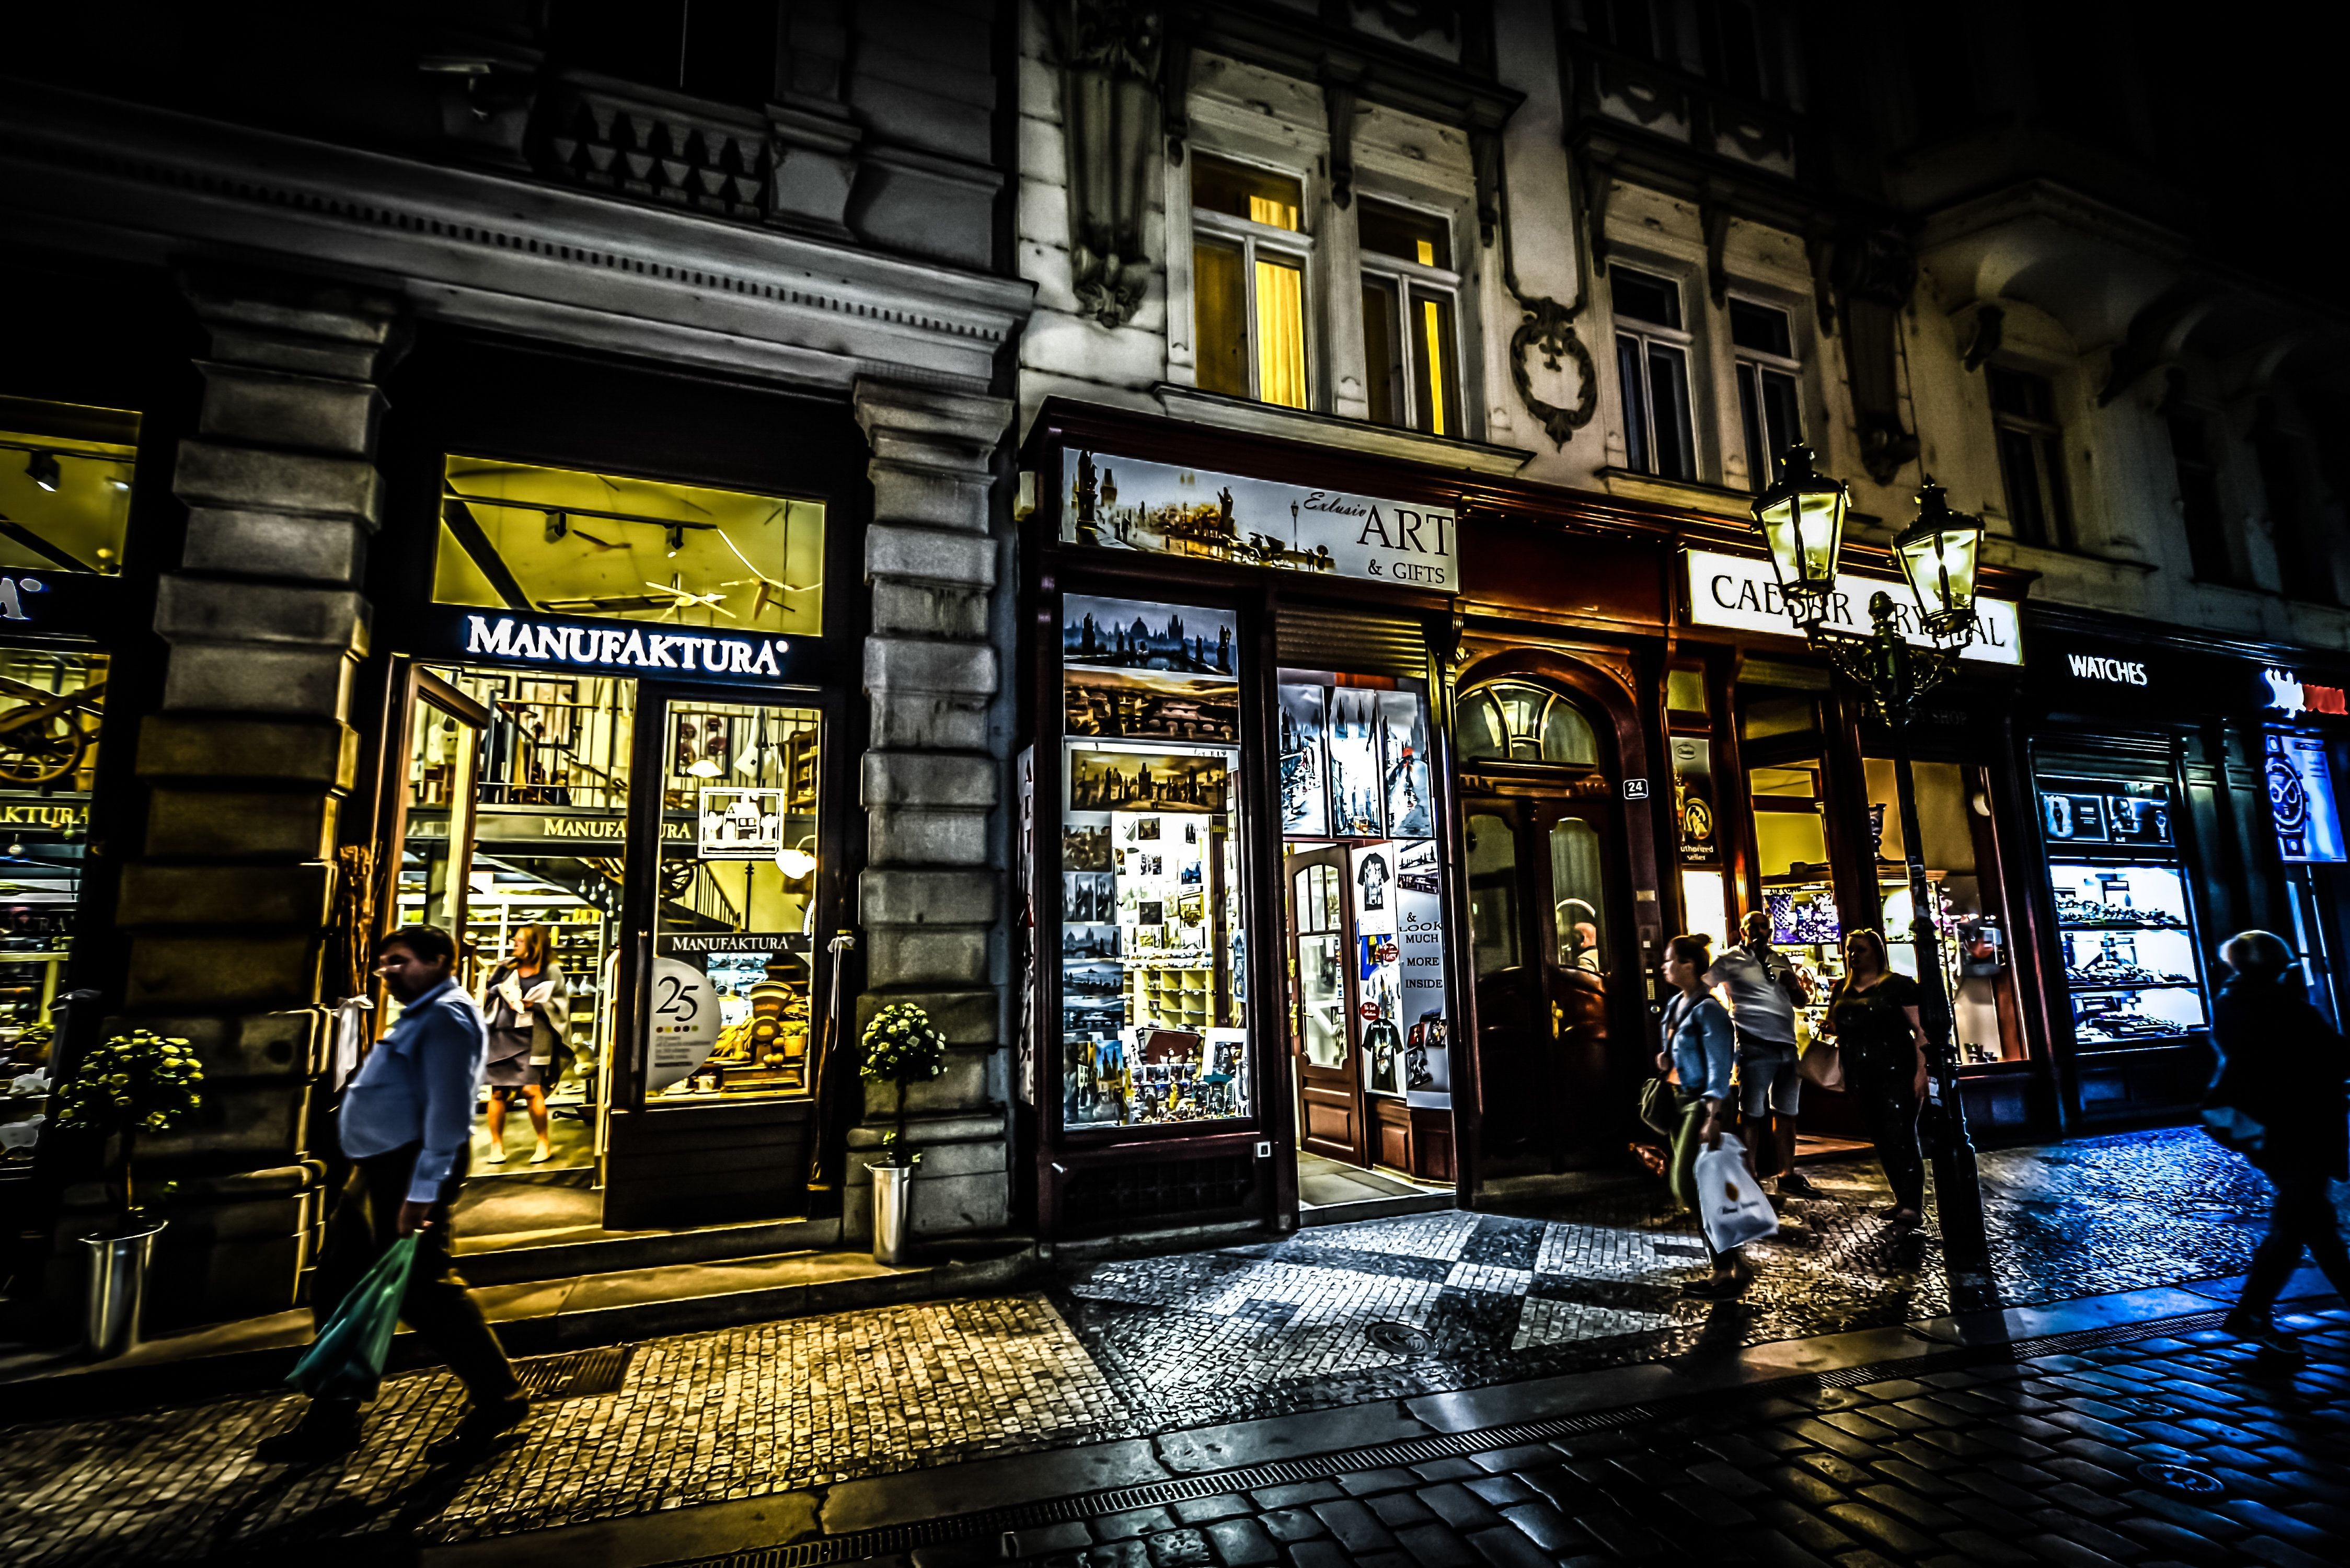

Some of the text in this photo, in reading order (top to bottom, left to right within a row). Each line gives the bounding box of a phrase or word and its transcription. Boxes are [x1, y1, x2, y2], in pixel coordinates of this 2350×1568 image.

[1356, 505, 1454, 556] ART
[1368, 559, 1445, 584] & GIFTS
[2068, 654, 2147, 686] WATCHES
[1628, 782, 1643, 792] 24
[0, 806, 88, 824] KTURA
[1407, 912, 1416, 922] &
[1399, 921, 1442, 931] LOOK
[672, 936, 788, 951] MANUFAKTURA
[1406, 934, 1439, 943] MUCH
[1407, 957, 1440, 966] MORE
[1406, 979, 1443, 988] INSIDE
[655, 975, 699, 1022] 25
